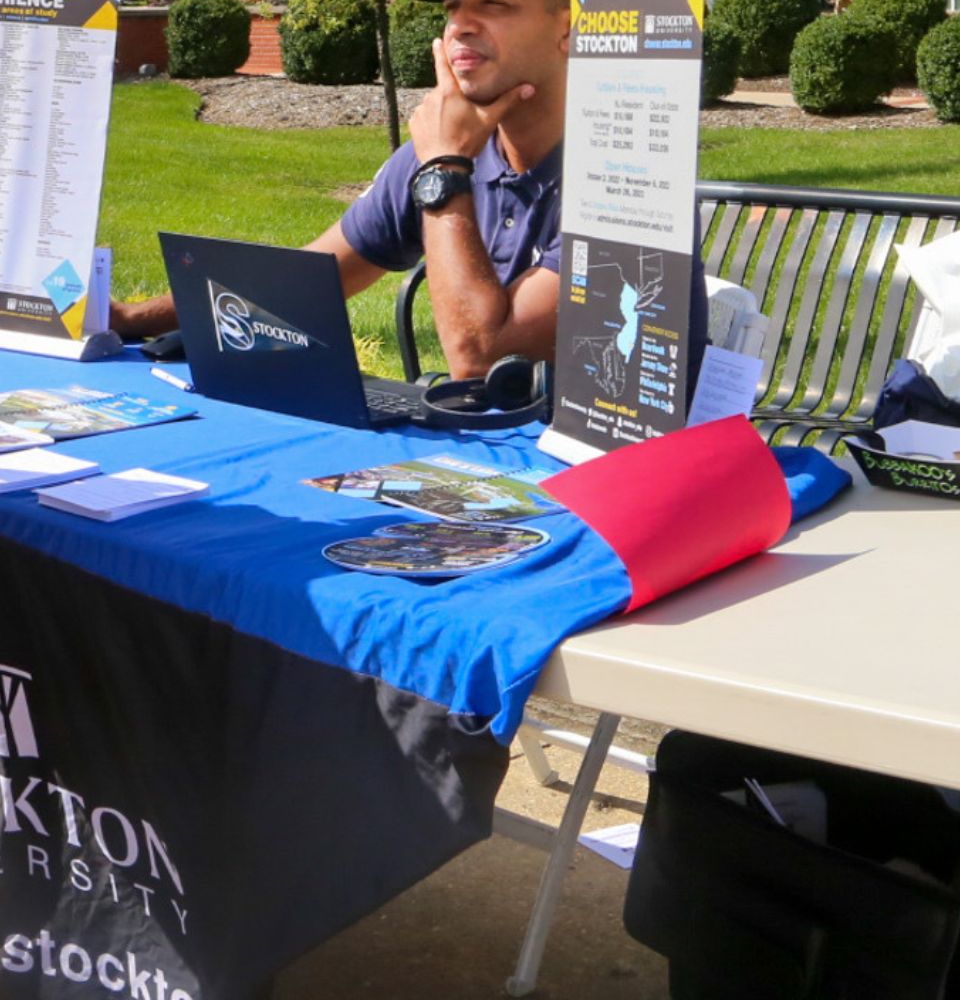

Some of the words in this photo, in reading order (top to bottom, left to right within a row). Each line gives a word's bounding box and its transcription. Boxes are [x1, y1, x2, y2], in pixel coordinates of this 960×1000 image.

[35, 7, 58, 18] study
[655, 15, 693, 27] STOCKTON
[578, 10, 639, 34] CHOOSE
[576, 35, 638, 53] STOCKTON
[252, 321, 309, 347] STOCKTON
